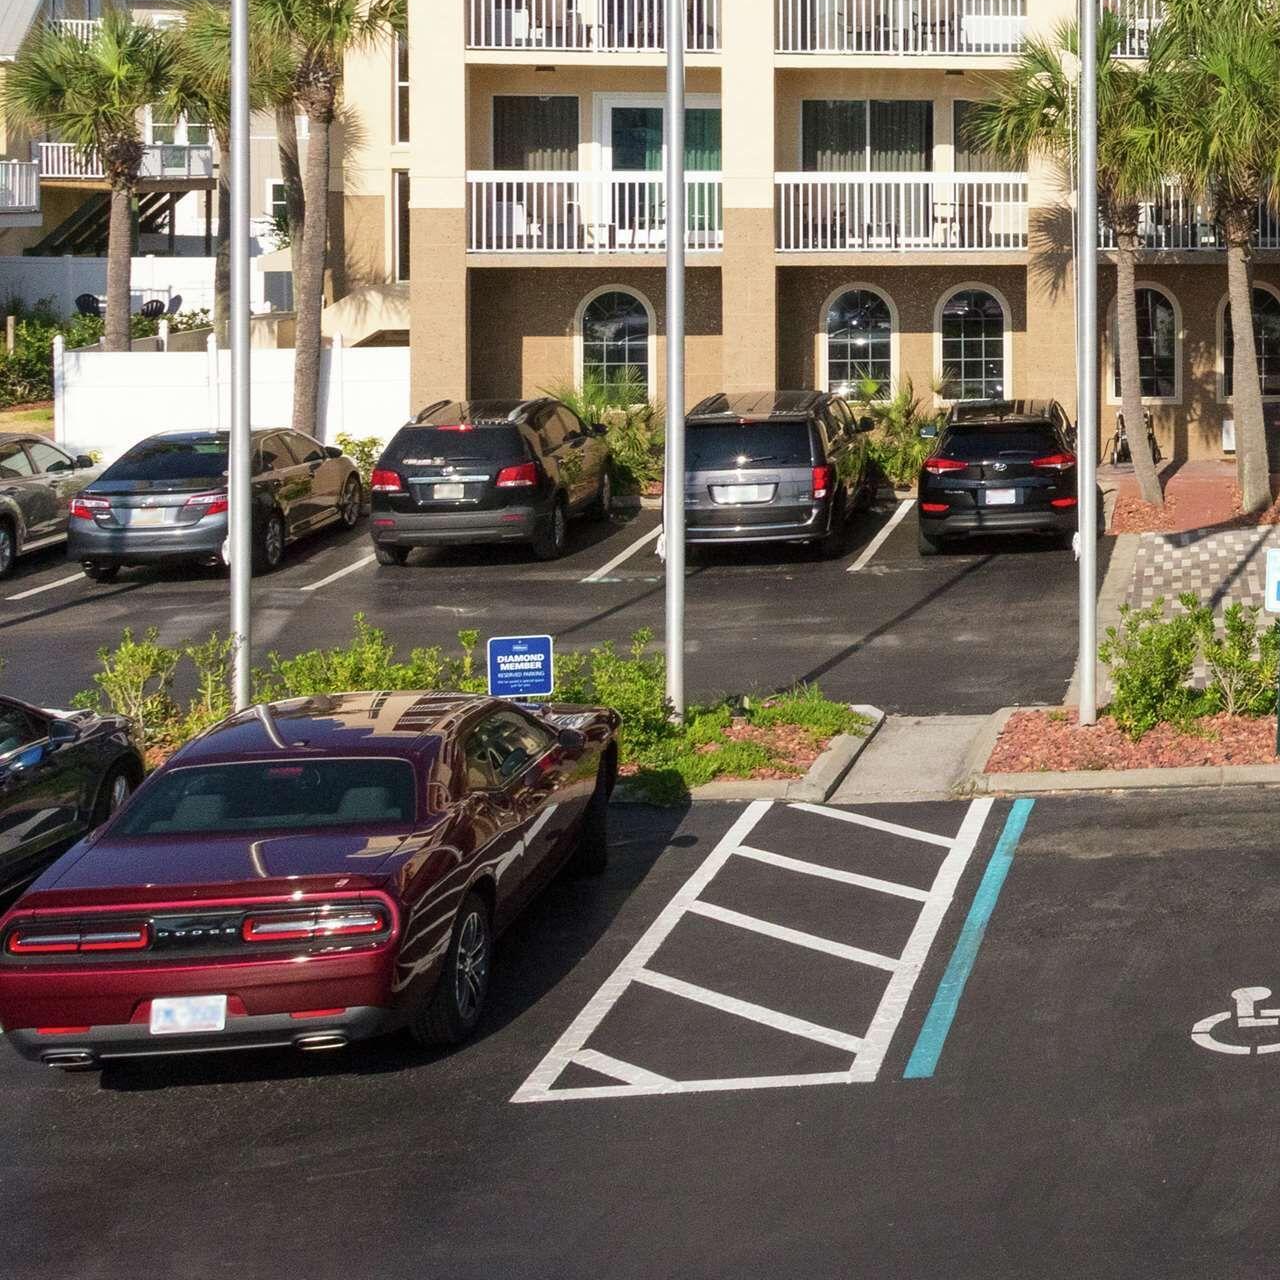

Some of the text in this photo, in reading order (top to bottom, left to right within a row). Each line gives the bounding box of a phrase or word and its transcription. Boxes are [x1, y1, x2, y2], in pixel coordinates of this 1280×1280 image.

[497, 654, 544, 663] DIAMOND
[501, 662, 542, 670] MEMBER
[158, 928, 235, 937] DODGE
